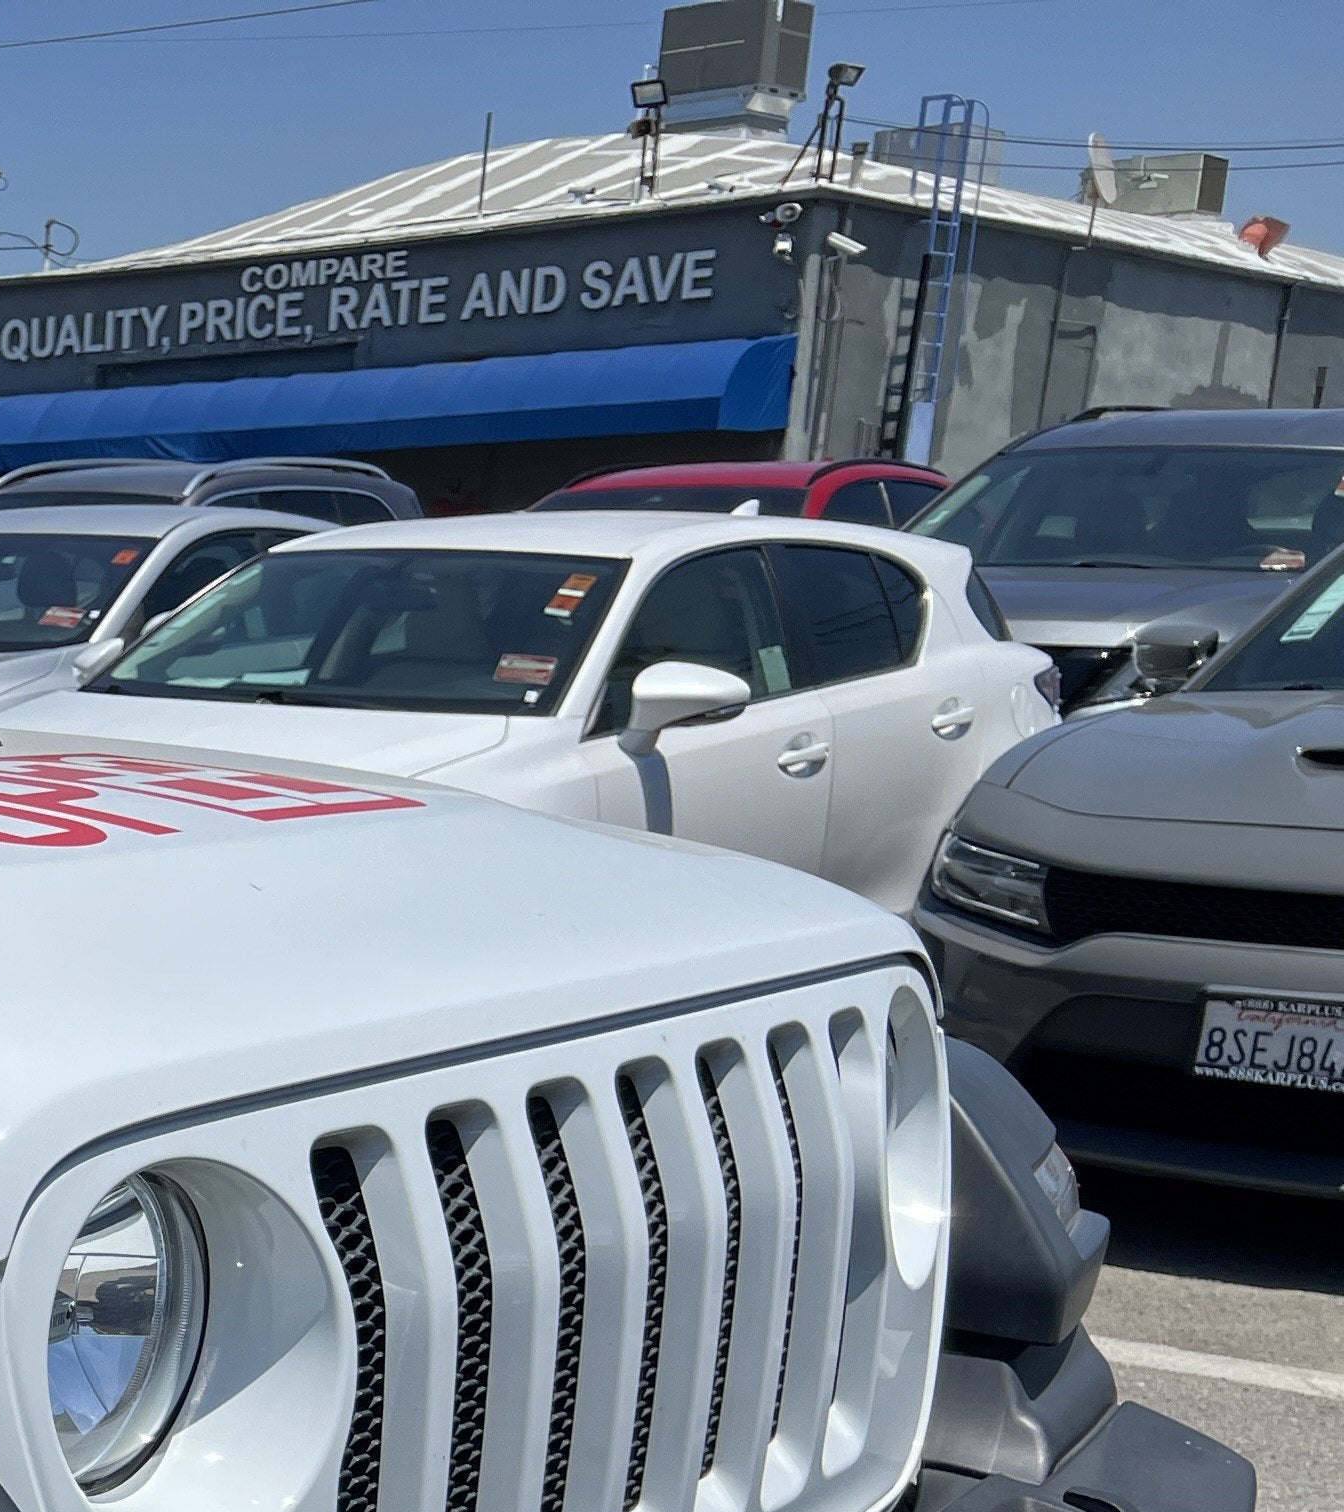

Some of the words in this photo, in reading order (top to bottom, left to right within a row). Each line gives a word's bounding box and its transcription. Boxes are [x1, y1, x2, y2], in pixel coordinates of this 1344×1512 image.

[240, 251, 408, 292] COMPARE
[0, 305, 170, 362] QUALITY,
[178, 291, 313, 344] PRICE,
[328, 276, 449, 332] RATE
[460, 265, 567, 322] AND
[579, 249, 716, 310] SAVE
[1205, 1026, 1344, 1076] 8SEJ84
